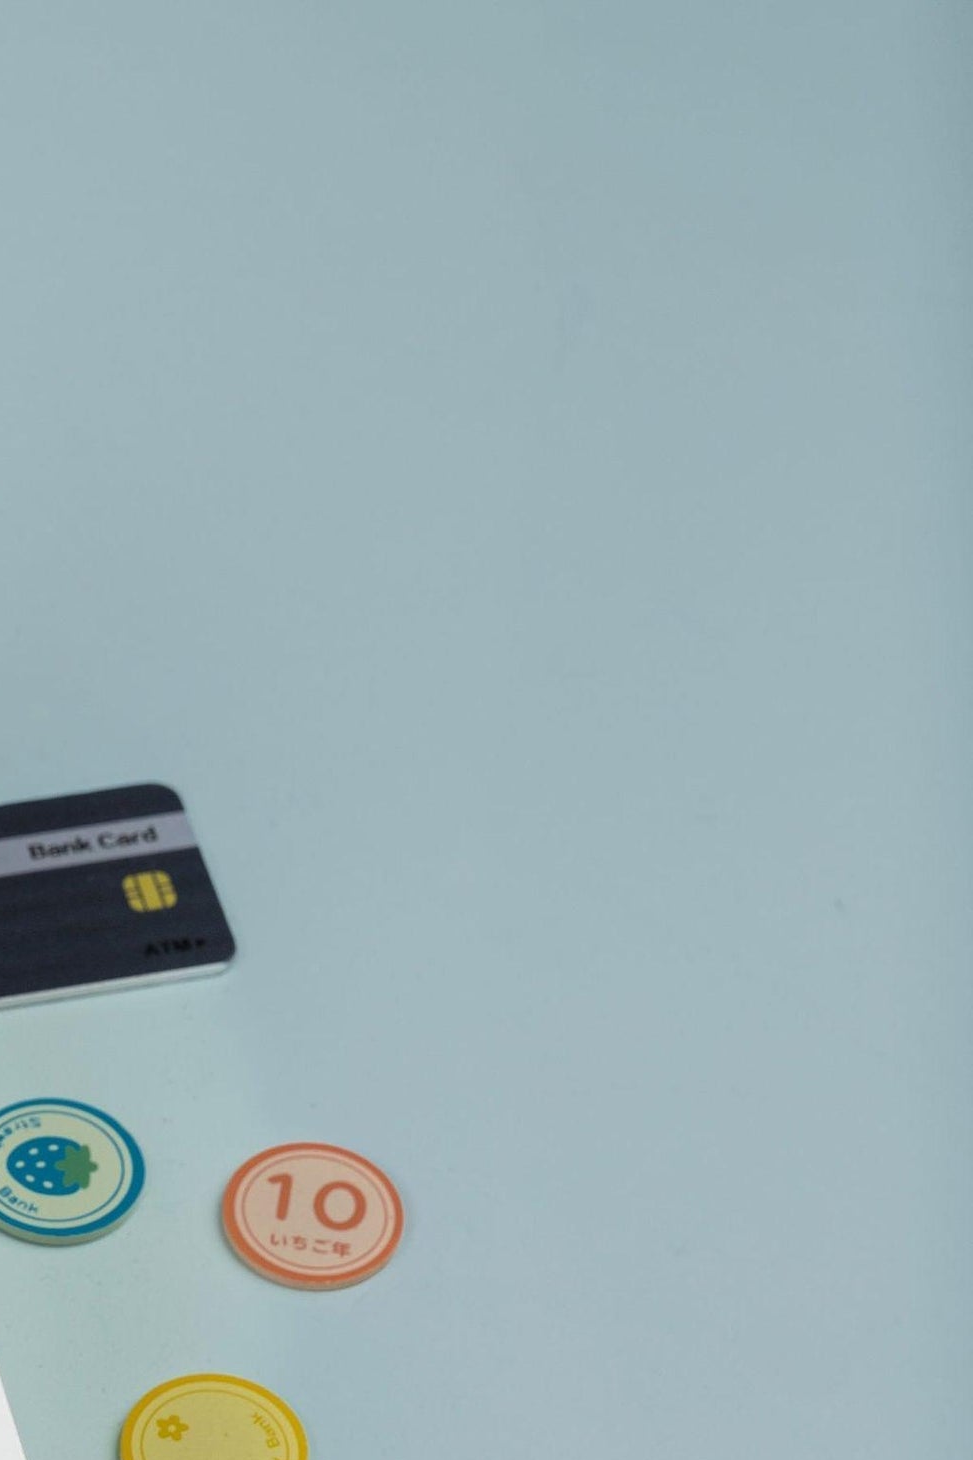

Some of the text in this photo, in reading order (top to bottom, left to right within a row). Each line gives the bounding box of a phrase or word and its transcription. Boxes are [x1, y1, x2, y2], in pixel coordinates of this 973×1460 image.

[28, 825, 158, 860] Bank Card
[267, 1172, 367, 1231] 10
[251, 1412, 280, 1449] Bank
